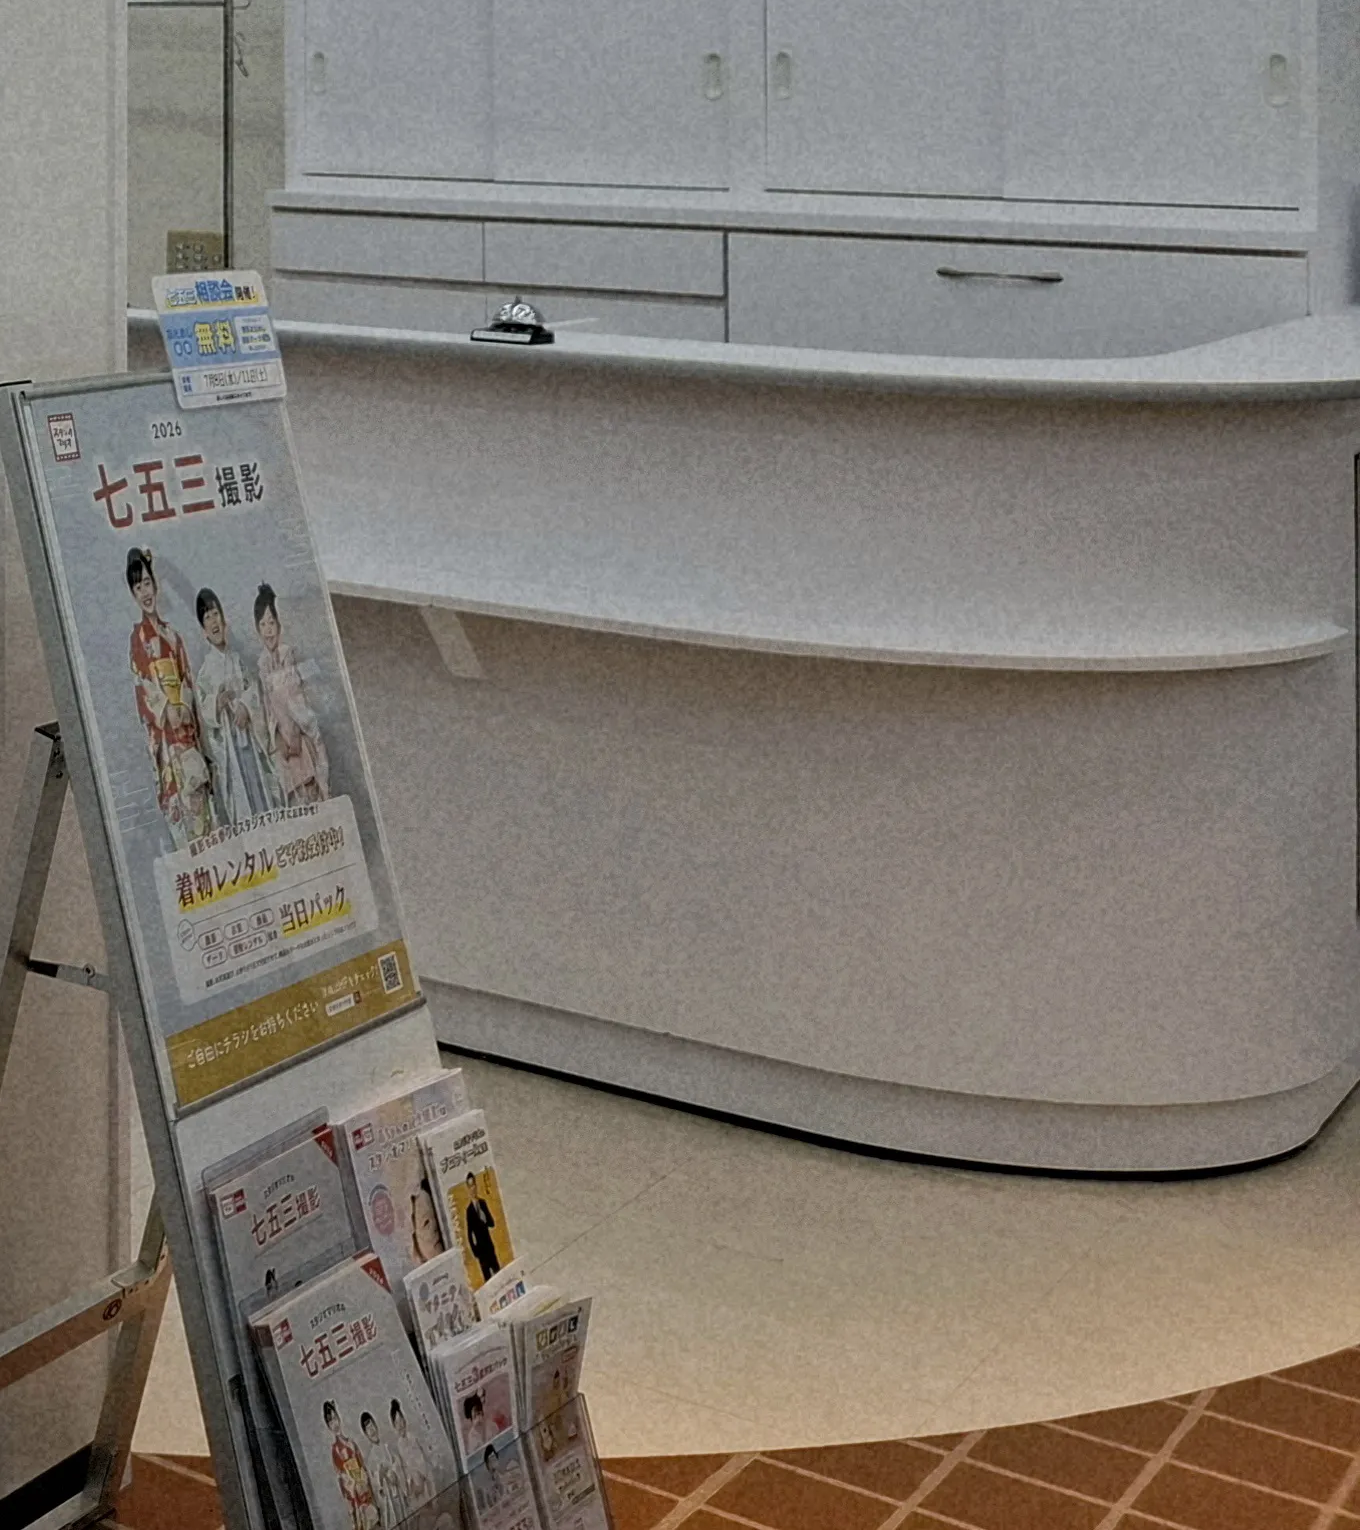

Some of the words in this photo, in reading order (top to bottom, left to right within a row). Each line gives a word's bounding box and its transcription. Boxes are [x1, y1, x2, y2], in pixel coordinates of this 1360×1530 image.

[151, 420, 182, 439] 2026
[93, 453, 264, 529] 七五三撮影
[278, 883, 347, 934] 当日パック
[251, 1184, 320, 1246] 七五三撮影
[299, 1314, 378, 1378] 七五三撮影
